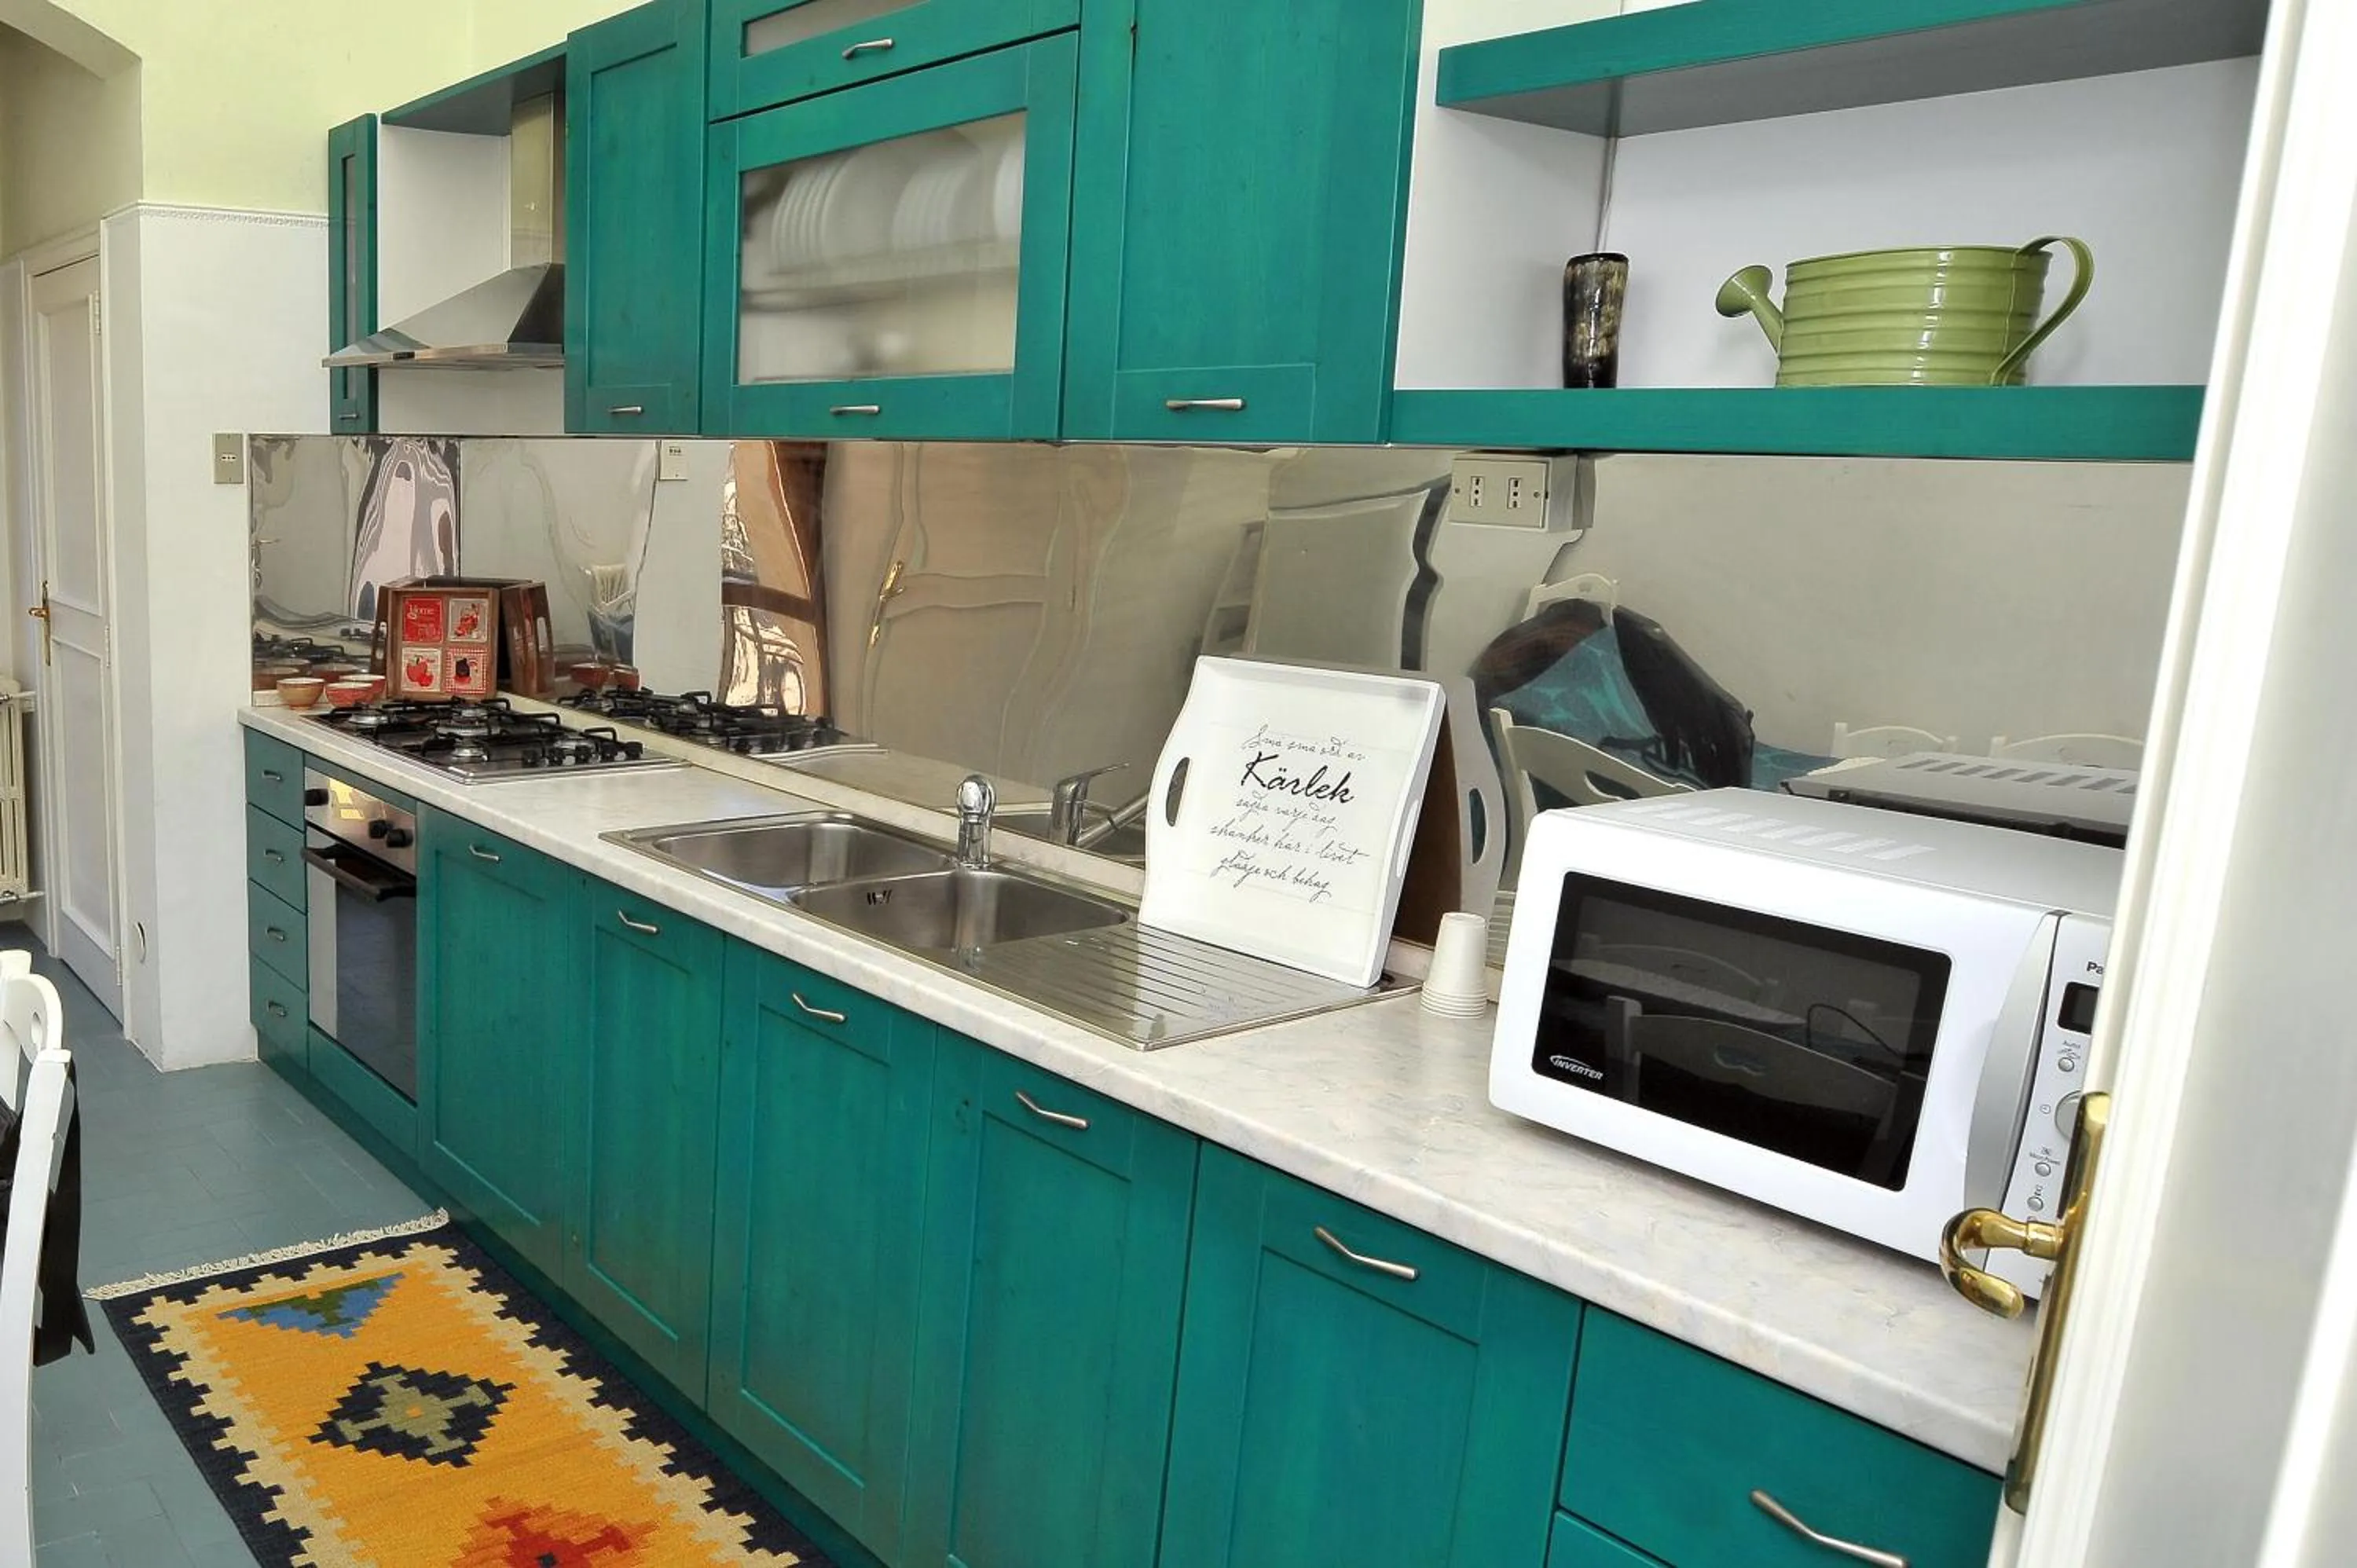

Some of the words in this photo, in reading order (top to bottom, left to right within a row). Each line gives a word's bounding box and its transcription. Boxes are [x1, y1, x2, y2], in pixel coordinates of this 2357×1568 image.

[1241, 750, 1354, 804] Kärlek
[2086, 961, 2104, 975] Pa
[1553, 1058, 1604, 1080] INVERTER
